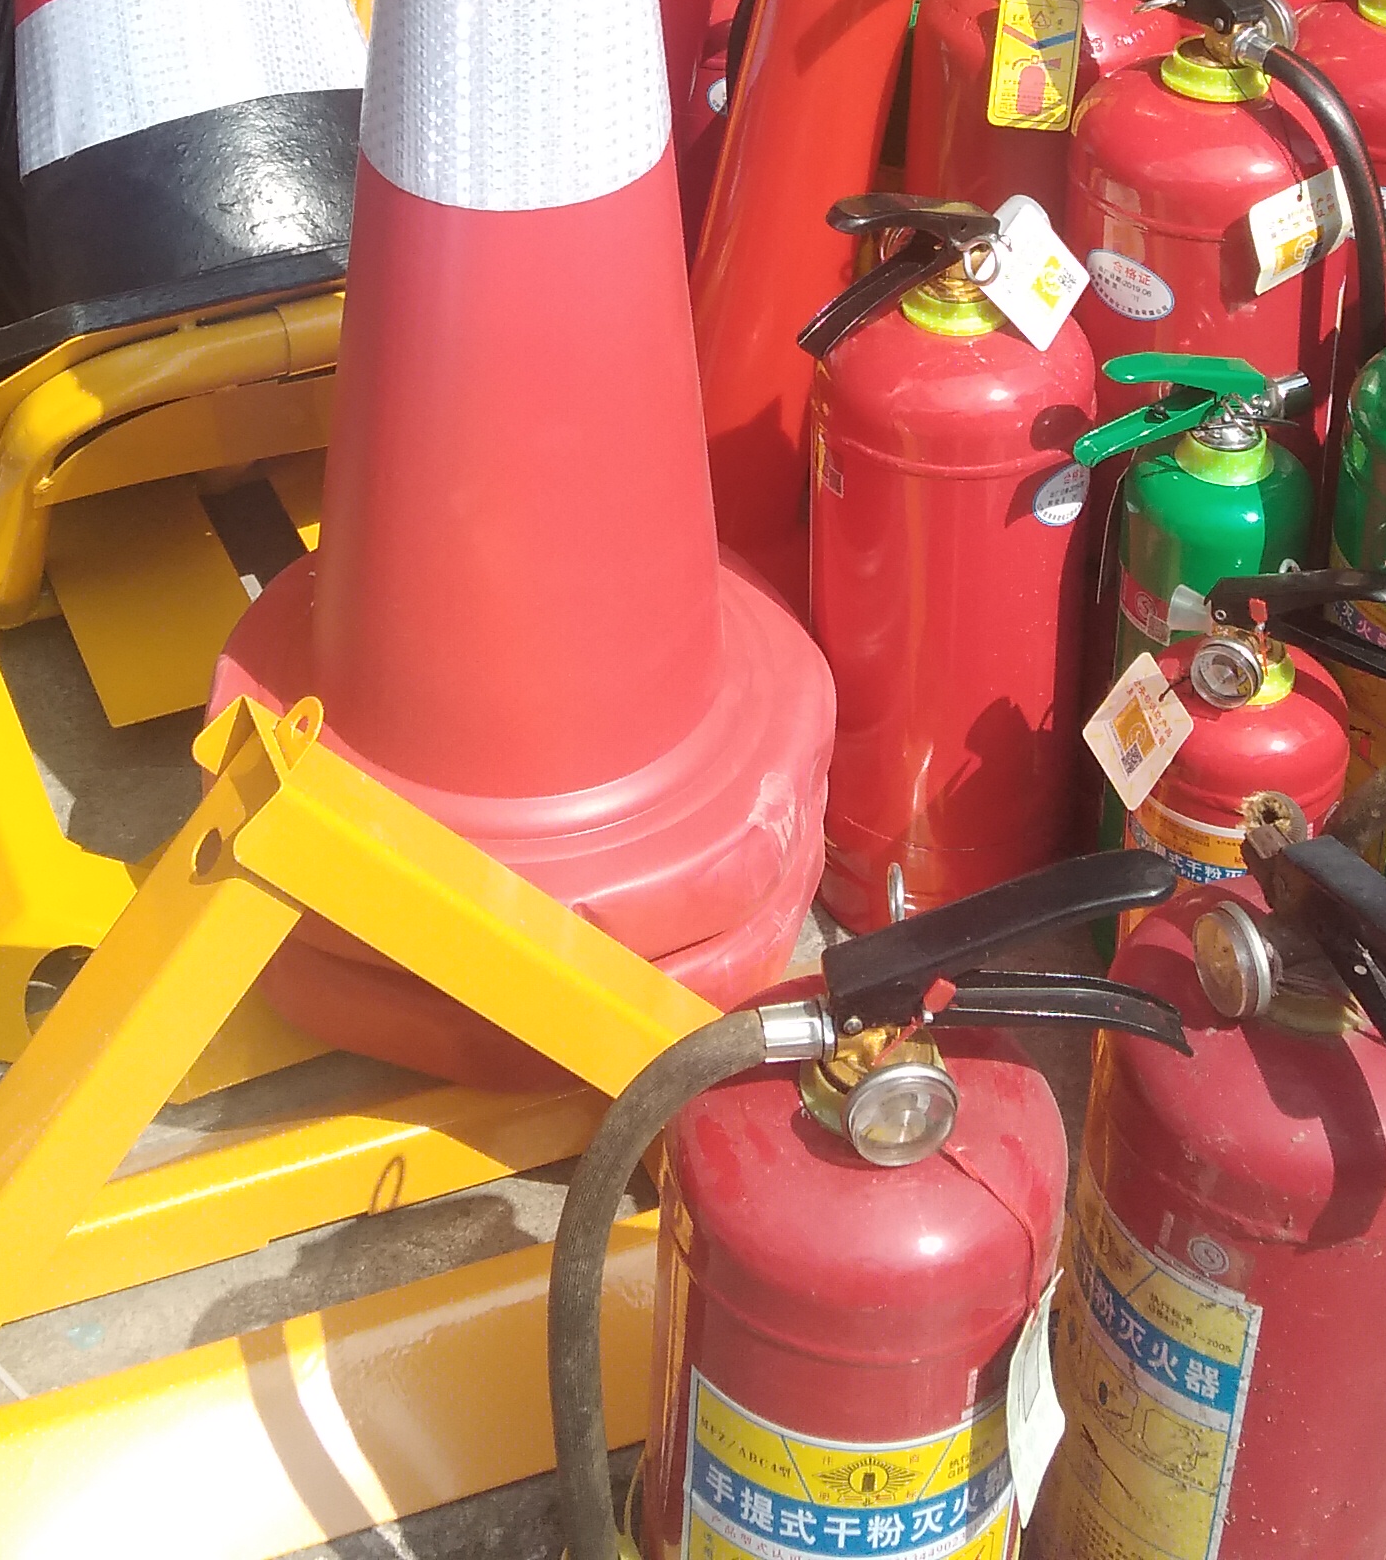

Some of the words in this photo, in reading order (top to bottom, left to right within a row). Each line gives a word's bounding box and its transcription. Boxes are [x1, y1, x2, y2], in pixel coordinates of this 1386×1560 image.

[1113, 260, 1152, 287] 合格证
[704, 1463, 1010, 1550] 手提式干粉灭火器
